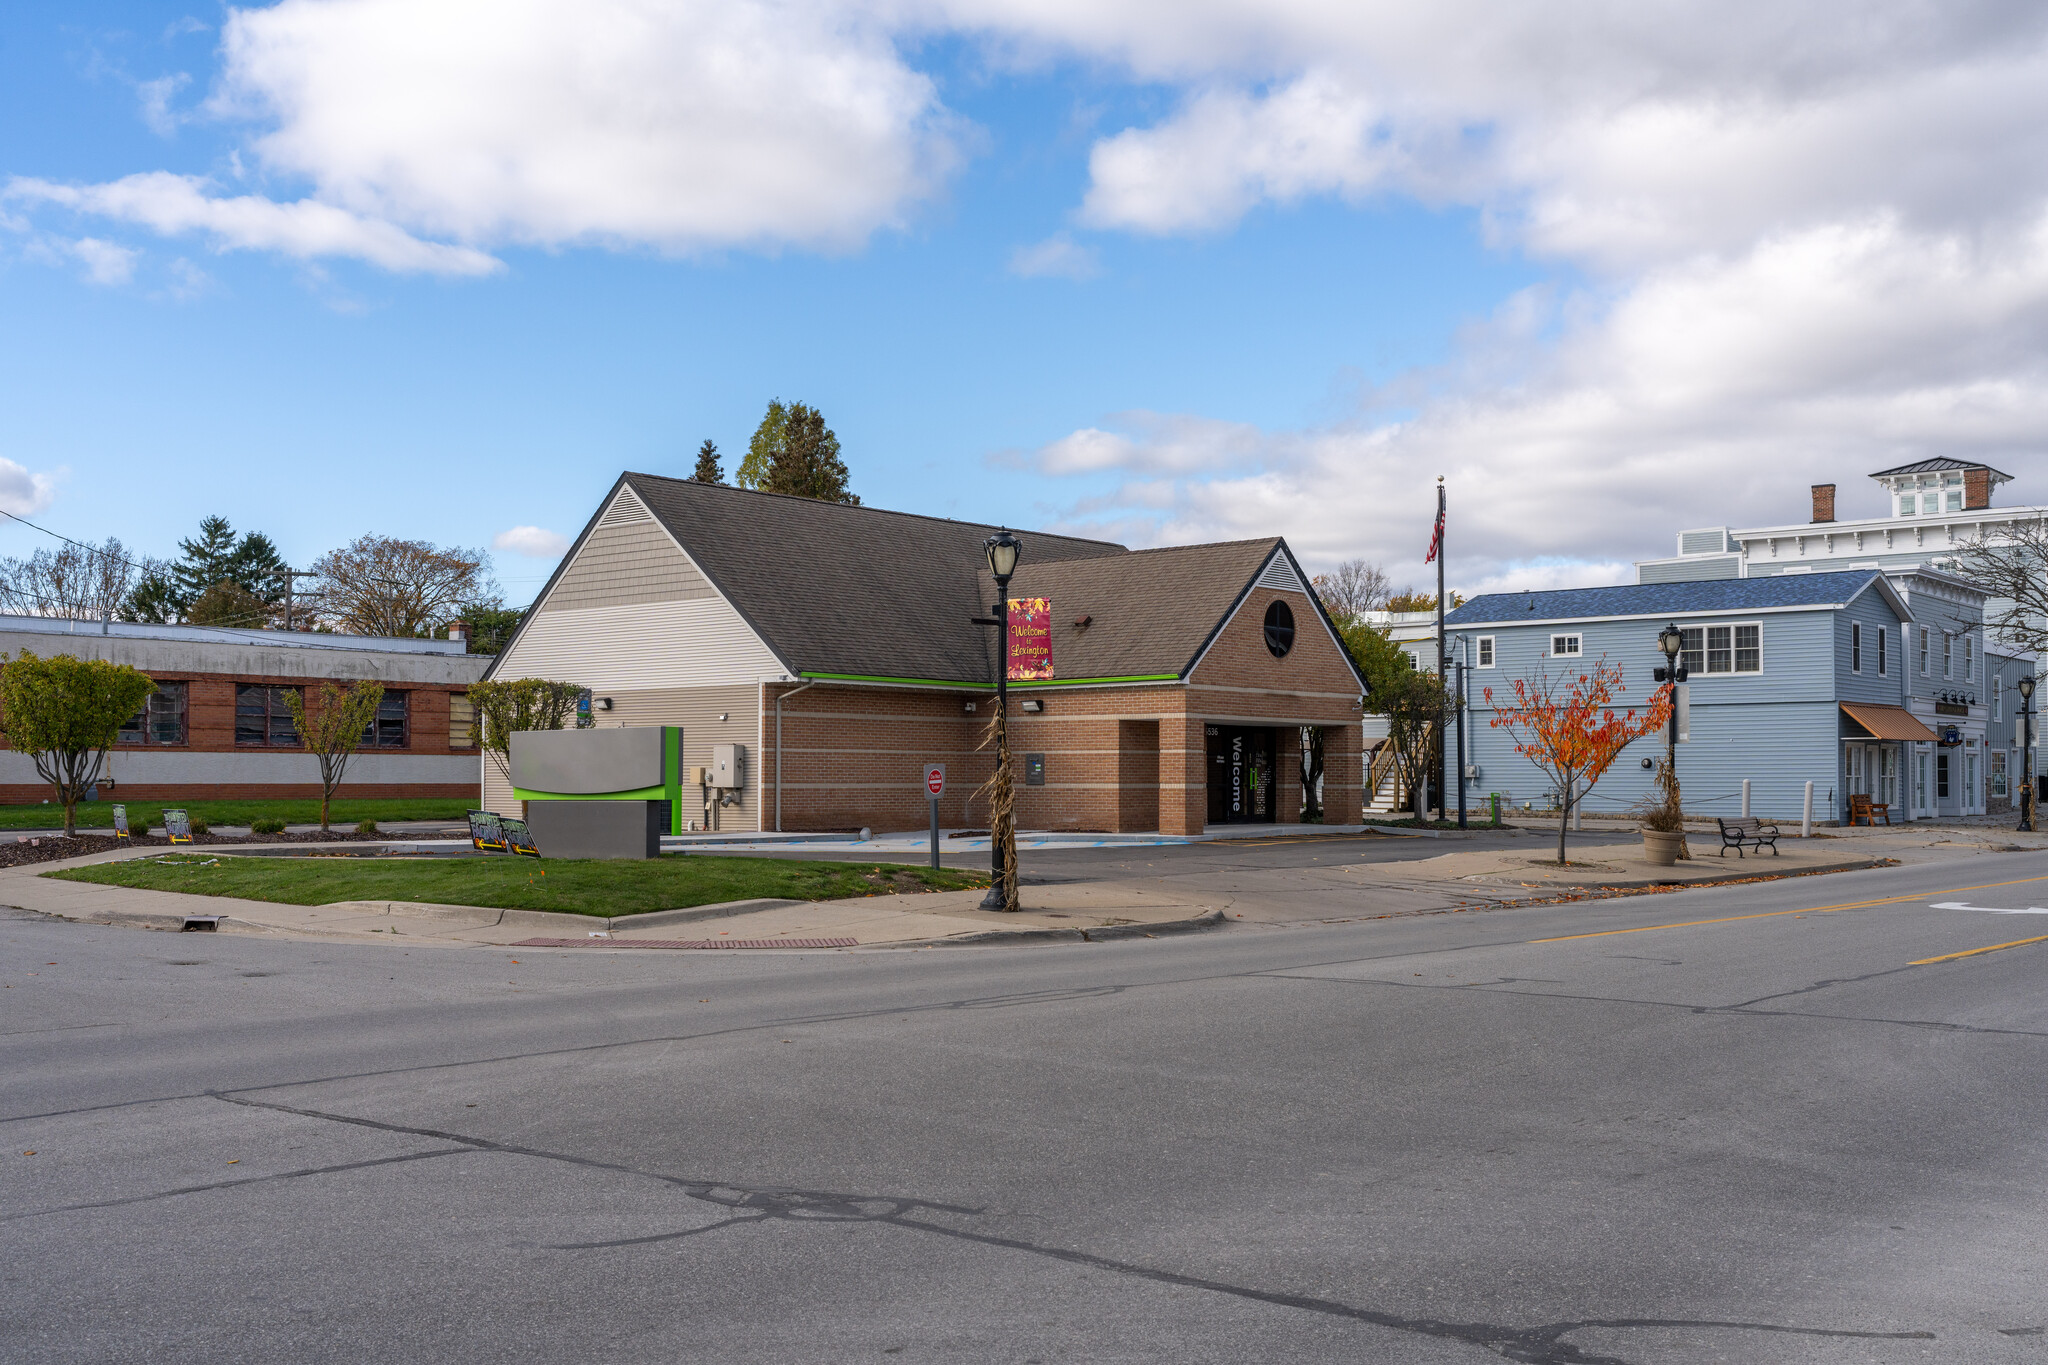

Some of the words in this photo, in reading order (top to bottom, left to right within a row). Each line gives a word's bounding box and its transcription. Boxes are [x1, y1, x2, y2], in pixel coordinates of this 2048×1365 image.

[1011, 625, 1047, 637] Welcome
[1011, 644, 1049, 658] Lexington
[1232, 736, 1242, 812] Welcome
